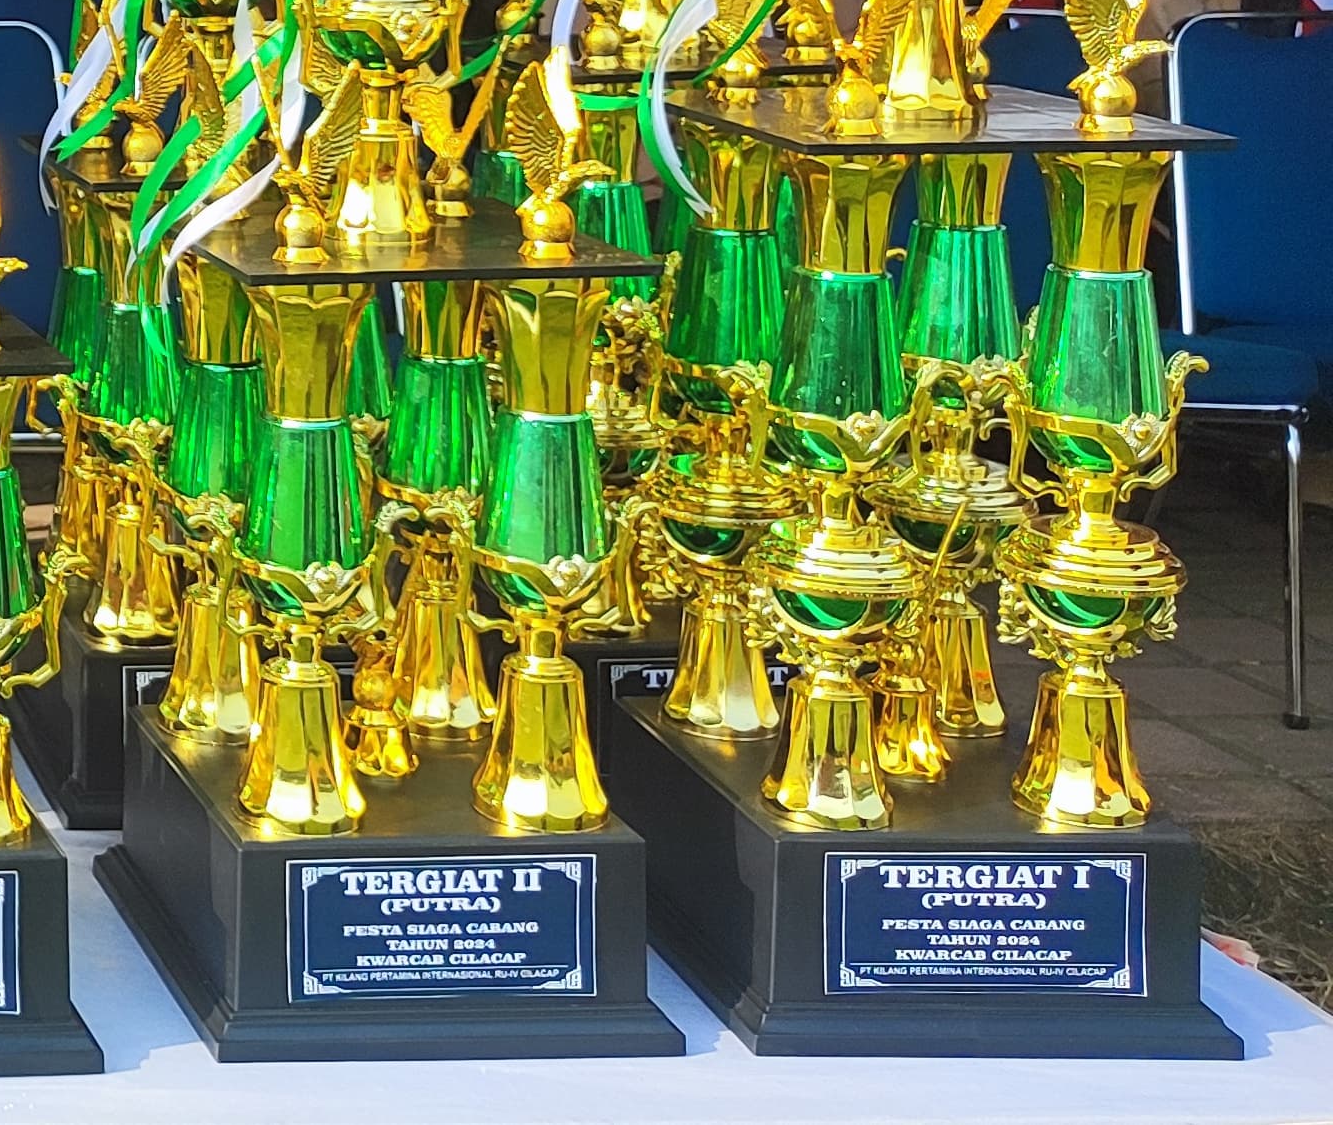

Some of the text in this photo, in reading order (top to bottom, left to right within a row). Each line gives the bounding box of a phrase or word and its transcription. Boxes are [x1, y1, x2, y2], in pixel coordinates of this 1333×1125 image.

[340, 868, 542, 896] TERGIAT II
[880, 865, 1090, 890] TERGIAT I
[381, 897, 501, 915] (PUTRA)
[921, 892, 1047, 910] (PUTRA)
[343, 922, 539, 937] PESTA SIAGA CABANG
[882, 919, 1085, 931] PESTA SIAGA CABANG
[386, 939, 496, 951] TAHUN 2024
[927, 935, 1040, 946] TAHUN 2024
[357, 952, 527, 967] KWARCAB CILACAP
[895, 950, 1072, 961] KWARCAB CILACAP
[322, 973, 334, 982] PT
[336, 972, 368, 982] KILANG
[370, 971, 420, 981] PERTAMINA
[423, 970, 493, 980] INTERNASIONAL
[520, 969, 559, 979] CILACAP
[860, 966, 1106, 976] PT KILANG PERTAMINA INTERNASIONAL RU-IV CILACAP
